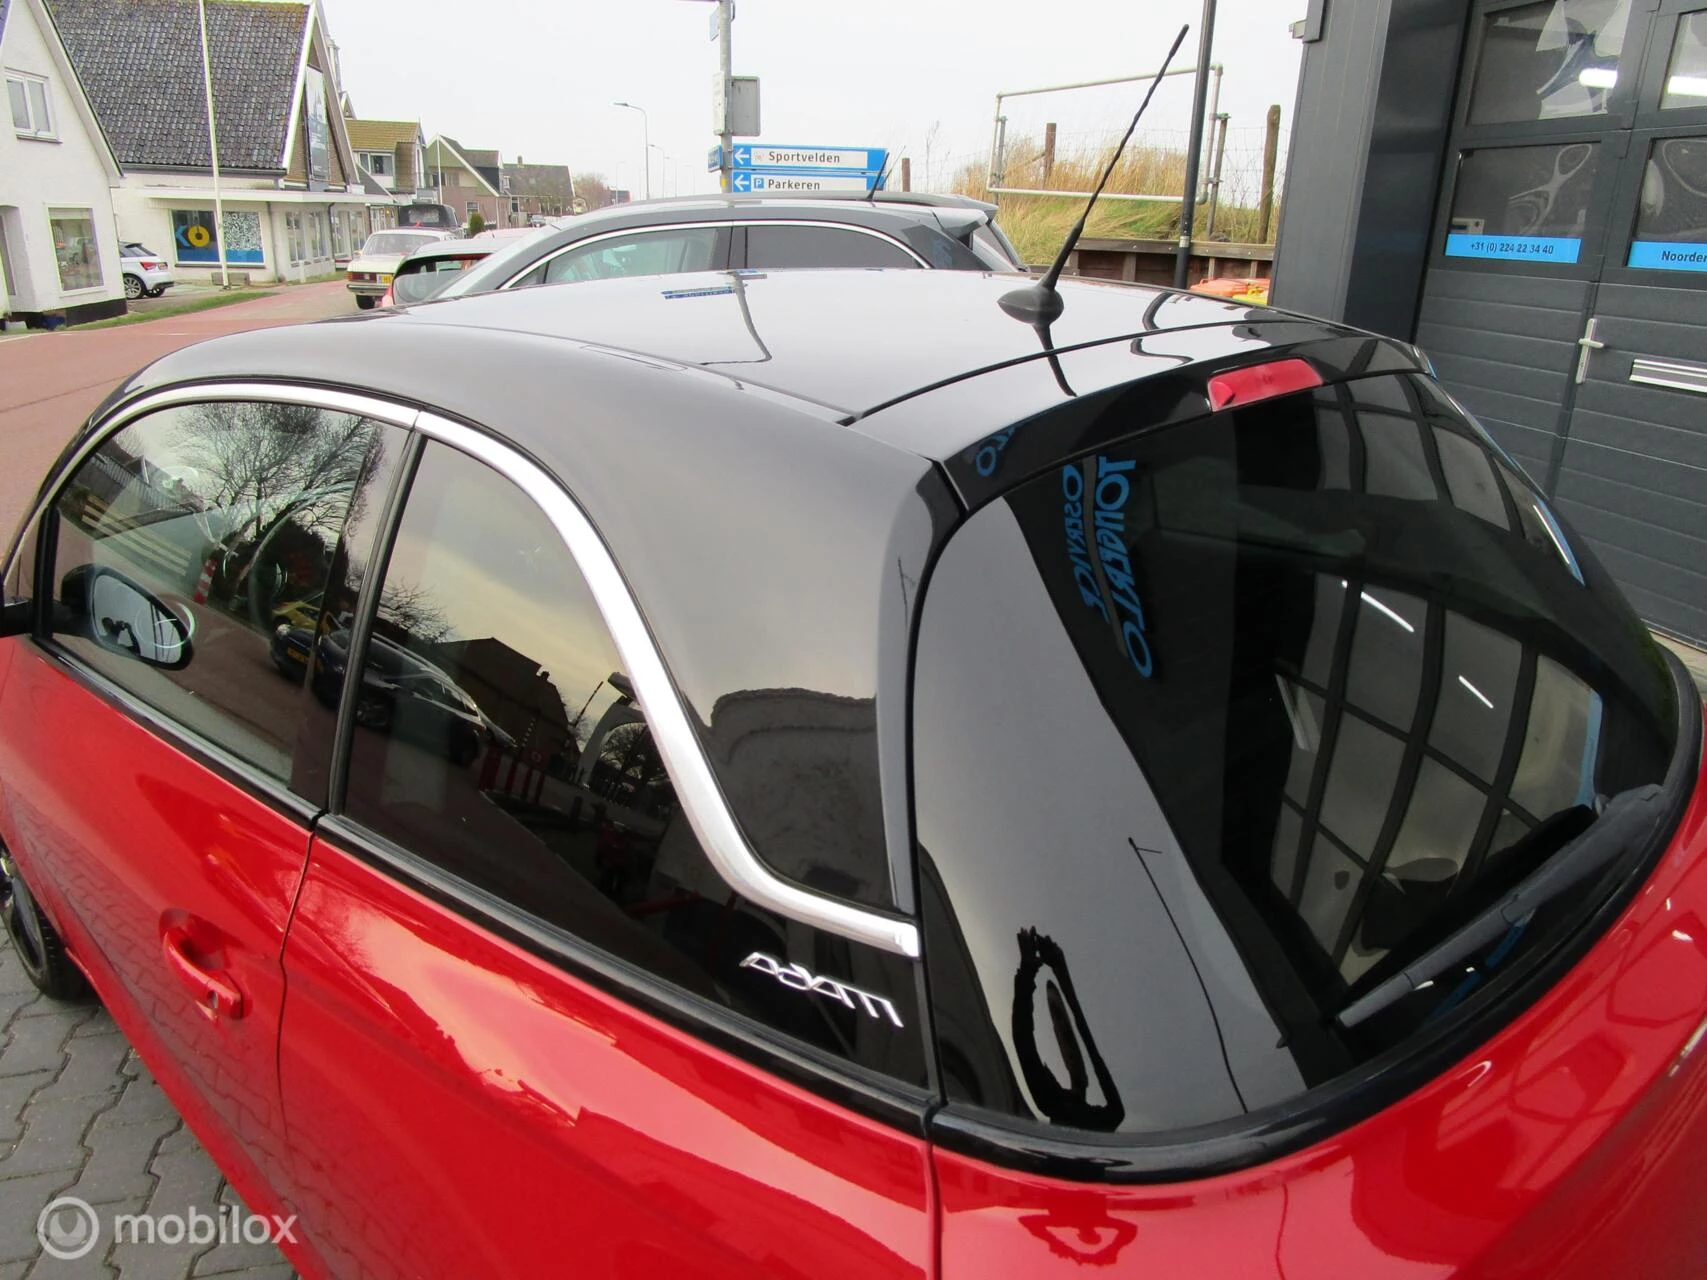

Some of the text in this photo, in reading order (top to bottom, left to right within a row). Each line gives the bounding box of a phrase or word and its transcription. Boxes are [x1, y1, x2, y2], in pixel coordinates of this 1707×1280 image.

[768, 151, 841, 164] Sportvelden
[768, 179, 820, 190] Parkeren
[1470, 242, 1554, 254] +31 (0) 224 22 34 40
